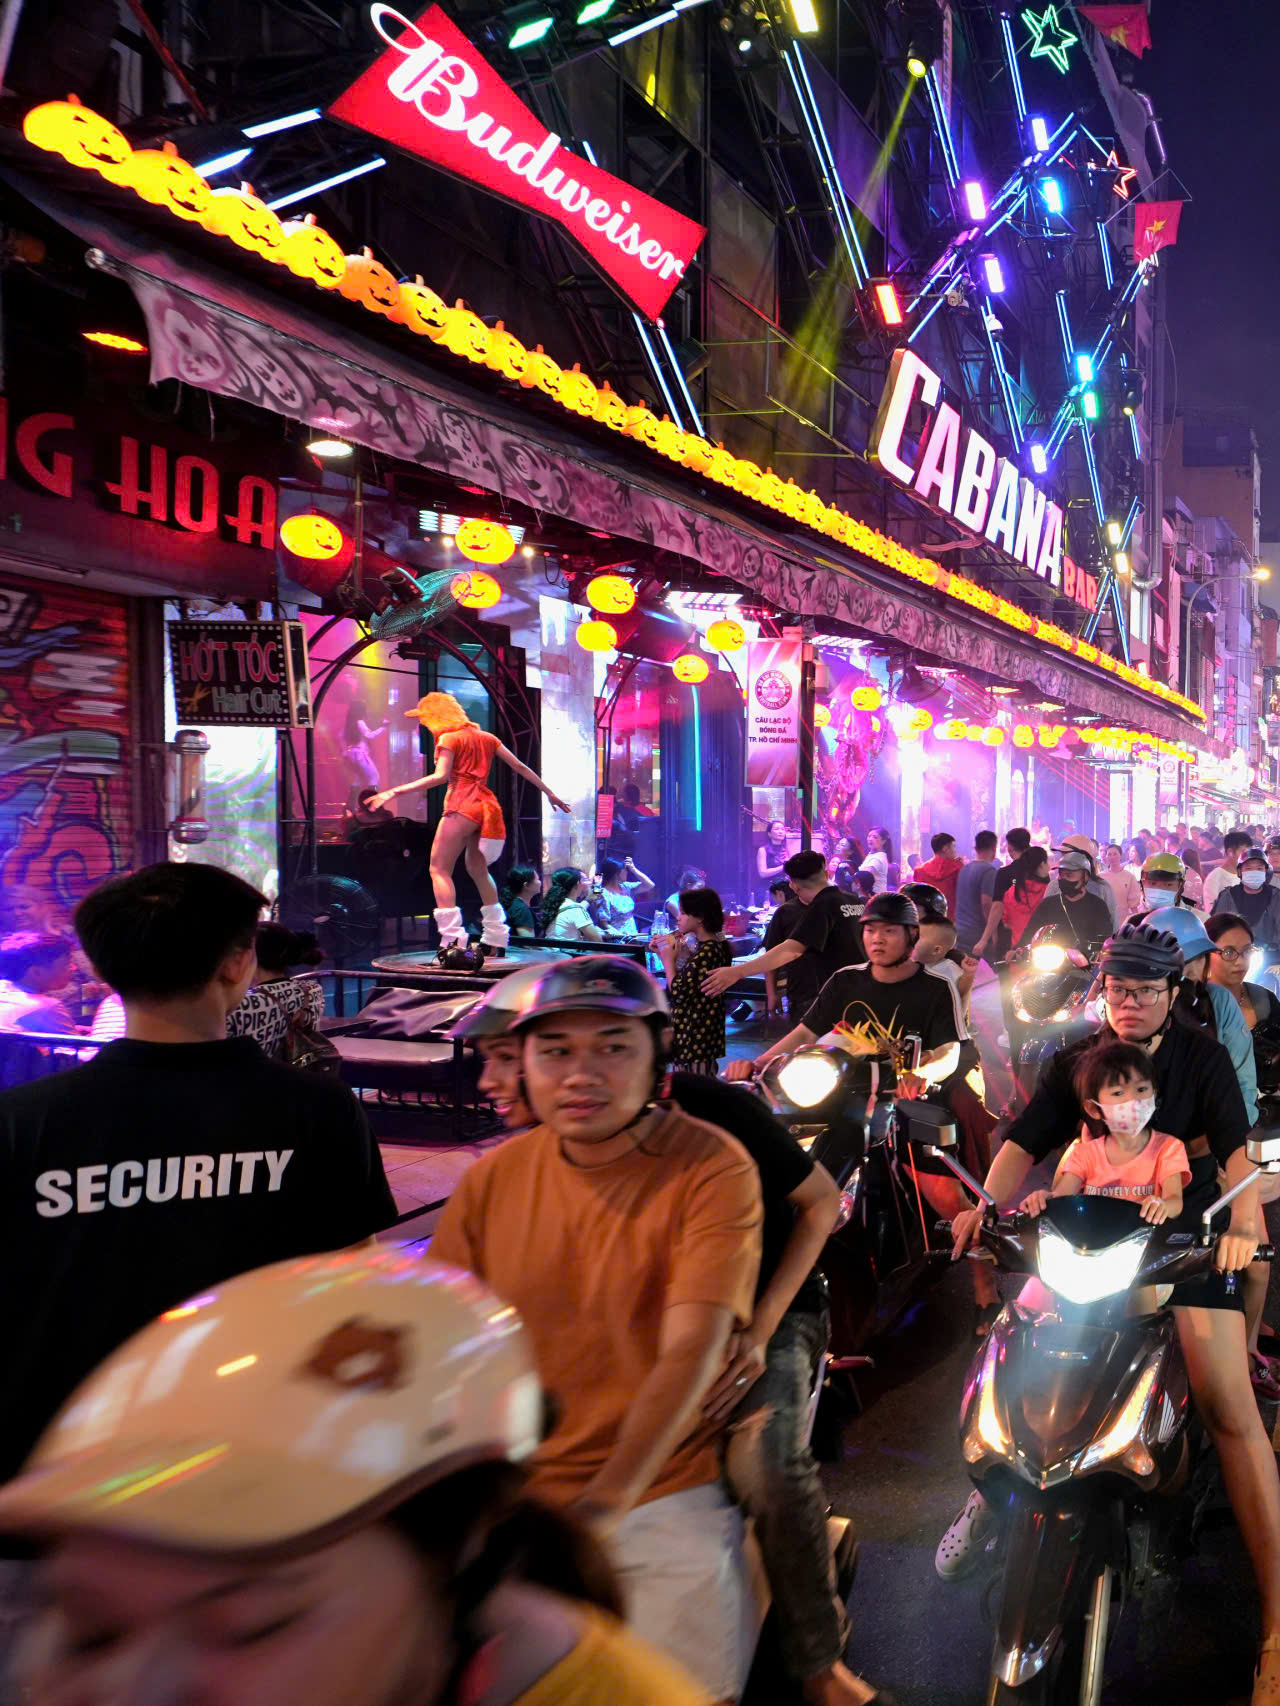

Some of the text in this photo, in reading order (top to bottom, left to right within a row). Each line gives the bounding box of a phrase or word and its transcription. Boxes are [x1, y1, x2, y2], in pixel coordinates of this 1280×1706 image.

[370, 2, 685, 283] Budweiser
[0, 396, 278, 550] G HOA
[877, 348, 1065, 587] CABANA
[1063, 555, 1098, 614] BAR
[232, 632, 280, 683] TÓC
[211, 685, 283, 714] Hair Cut
[34, 1149, 294, 1218] SECURITY
